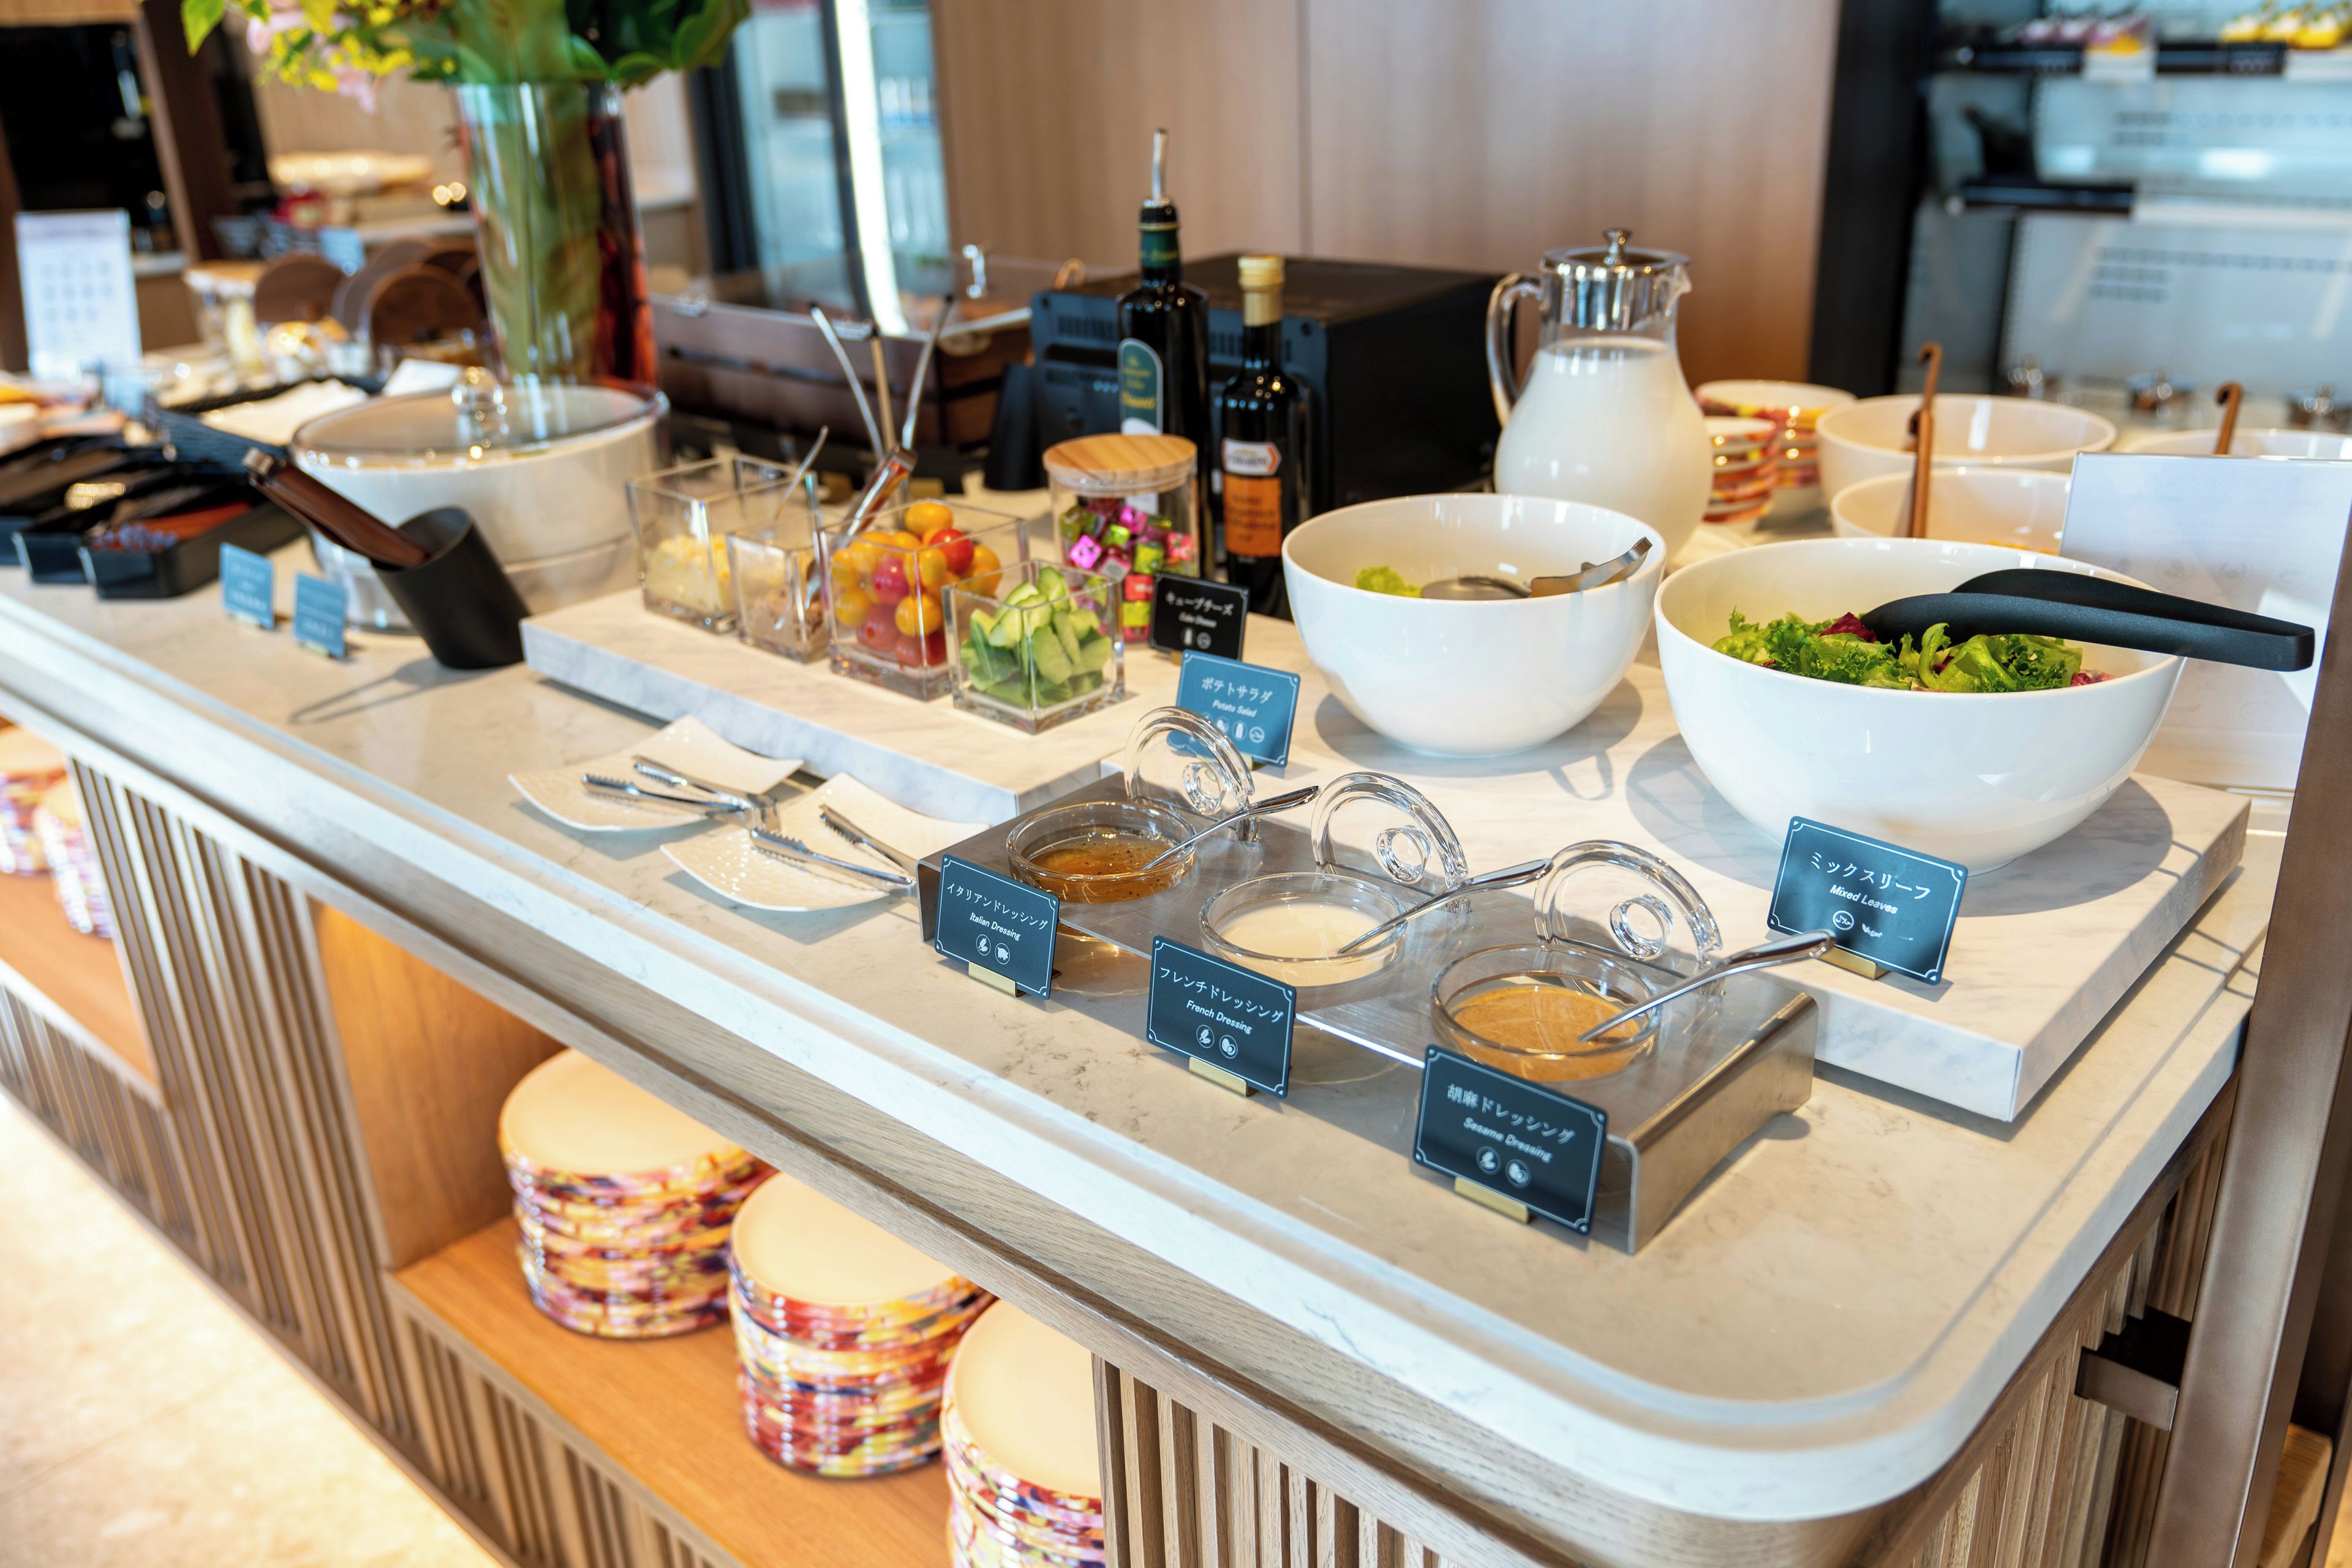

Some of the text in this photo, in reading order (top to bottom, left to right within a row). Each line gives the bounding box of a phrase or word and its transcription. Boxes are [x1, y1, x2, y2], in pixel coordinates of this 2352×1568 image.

[1202, 677, 1272, 703] ポテトサラダ
[1213, 699, 1257, 717] Potato Salad
[1811, 852, 1930, 899] ミックスリーフ
[947, 883, 1047, 929] イタリアンドレッシング
[1830, 884, 1898, 914] Mixed Leaves
[970, 913, 1020, 940] Italian Dressing
[1160, 966, 1283, 1023] フレンチドレッシング
[1186, 1000, 1252, 1034] French Dressing
[1447, 1084, 1575, 1144] 胡麻ドレッシング
[1464, 1118, 1553, 1163] Sesame Dressing
